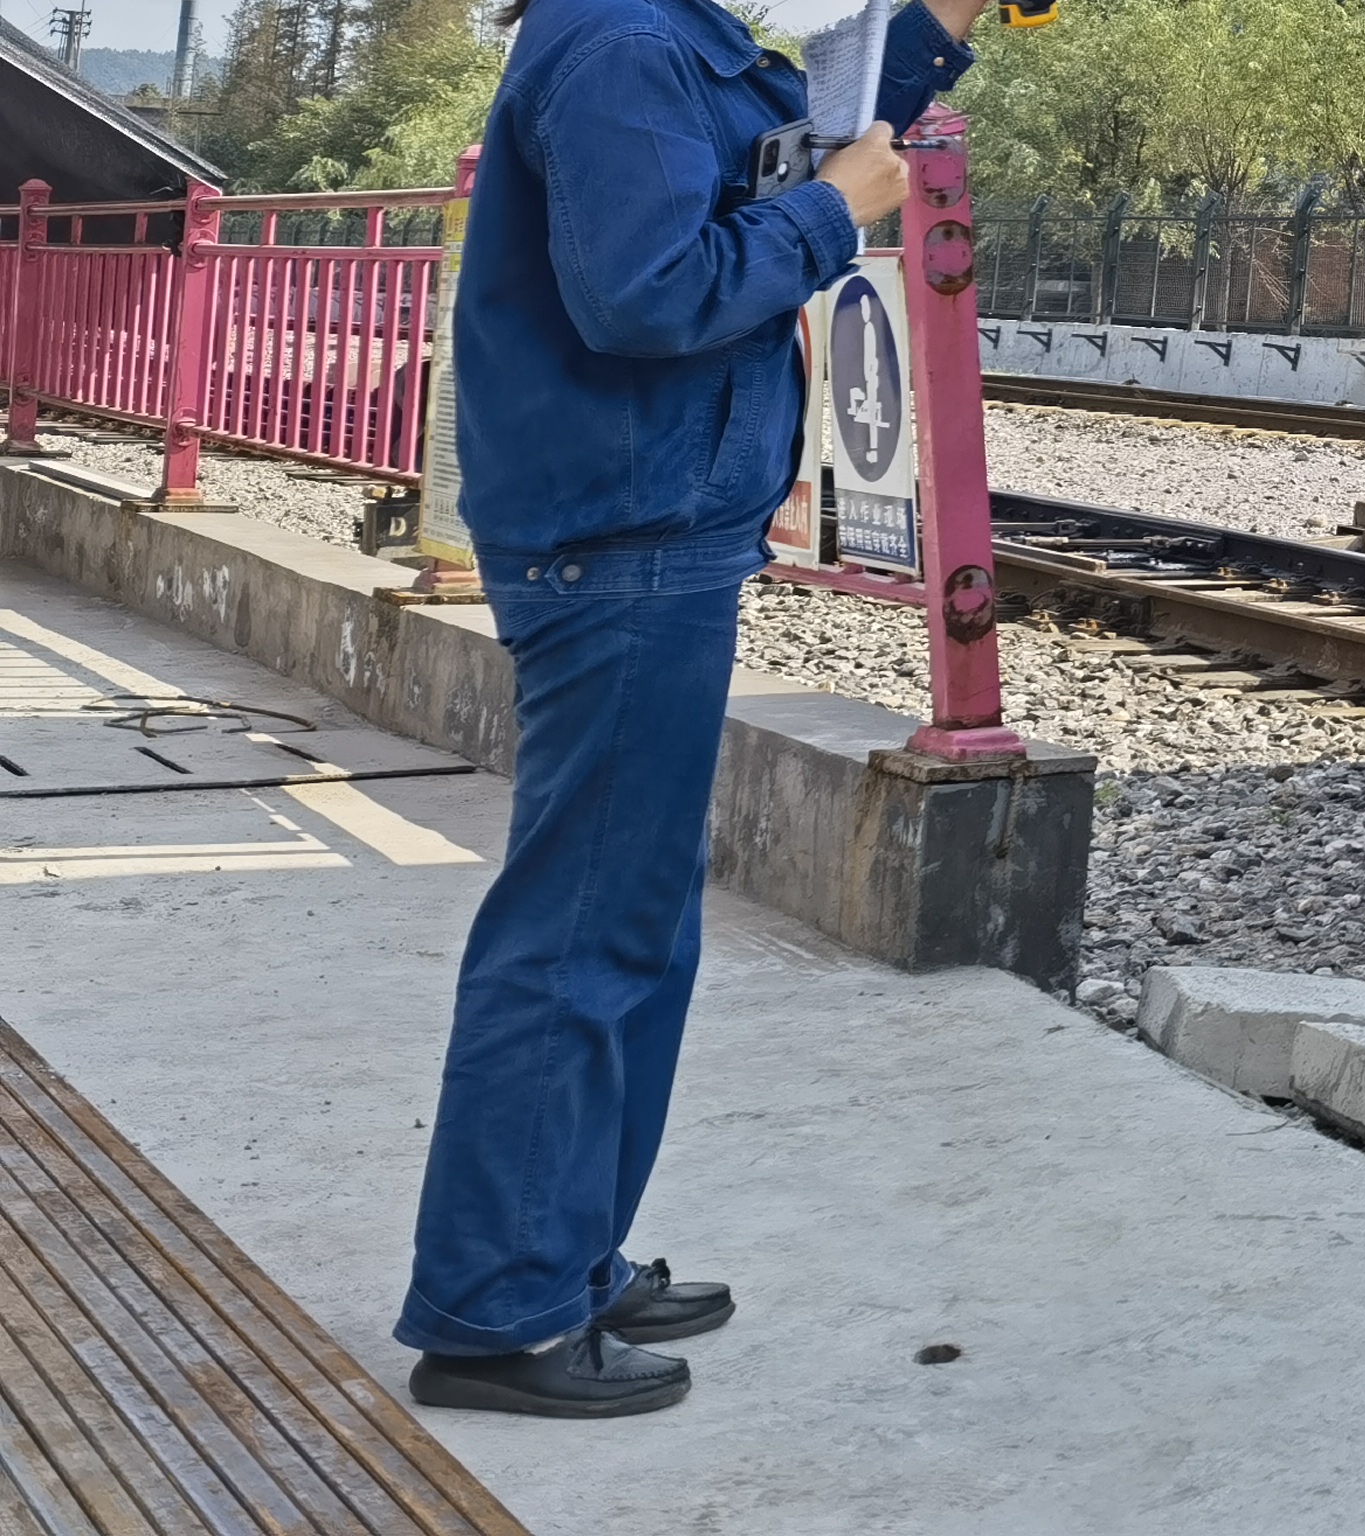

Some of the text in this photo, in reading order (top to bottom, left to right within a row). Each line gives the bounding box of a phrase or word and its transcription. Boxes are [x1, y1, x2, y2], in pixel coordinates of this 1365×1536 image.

[837, 497, 908, 530] 进入作业现场
[838, 526, 909, 559] 劳保用品穿戴齐全
